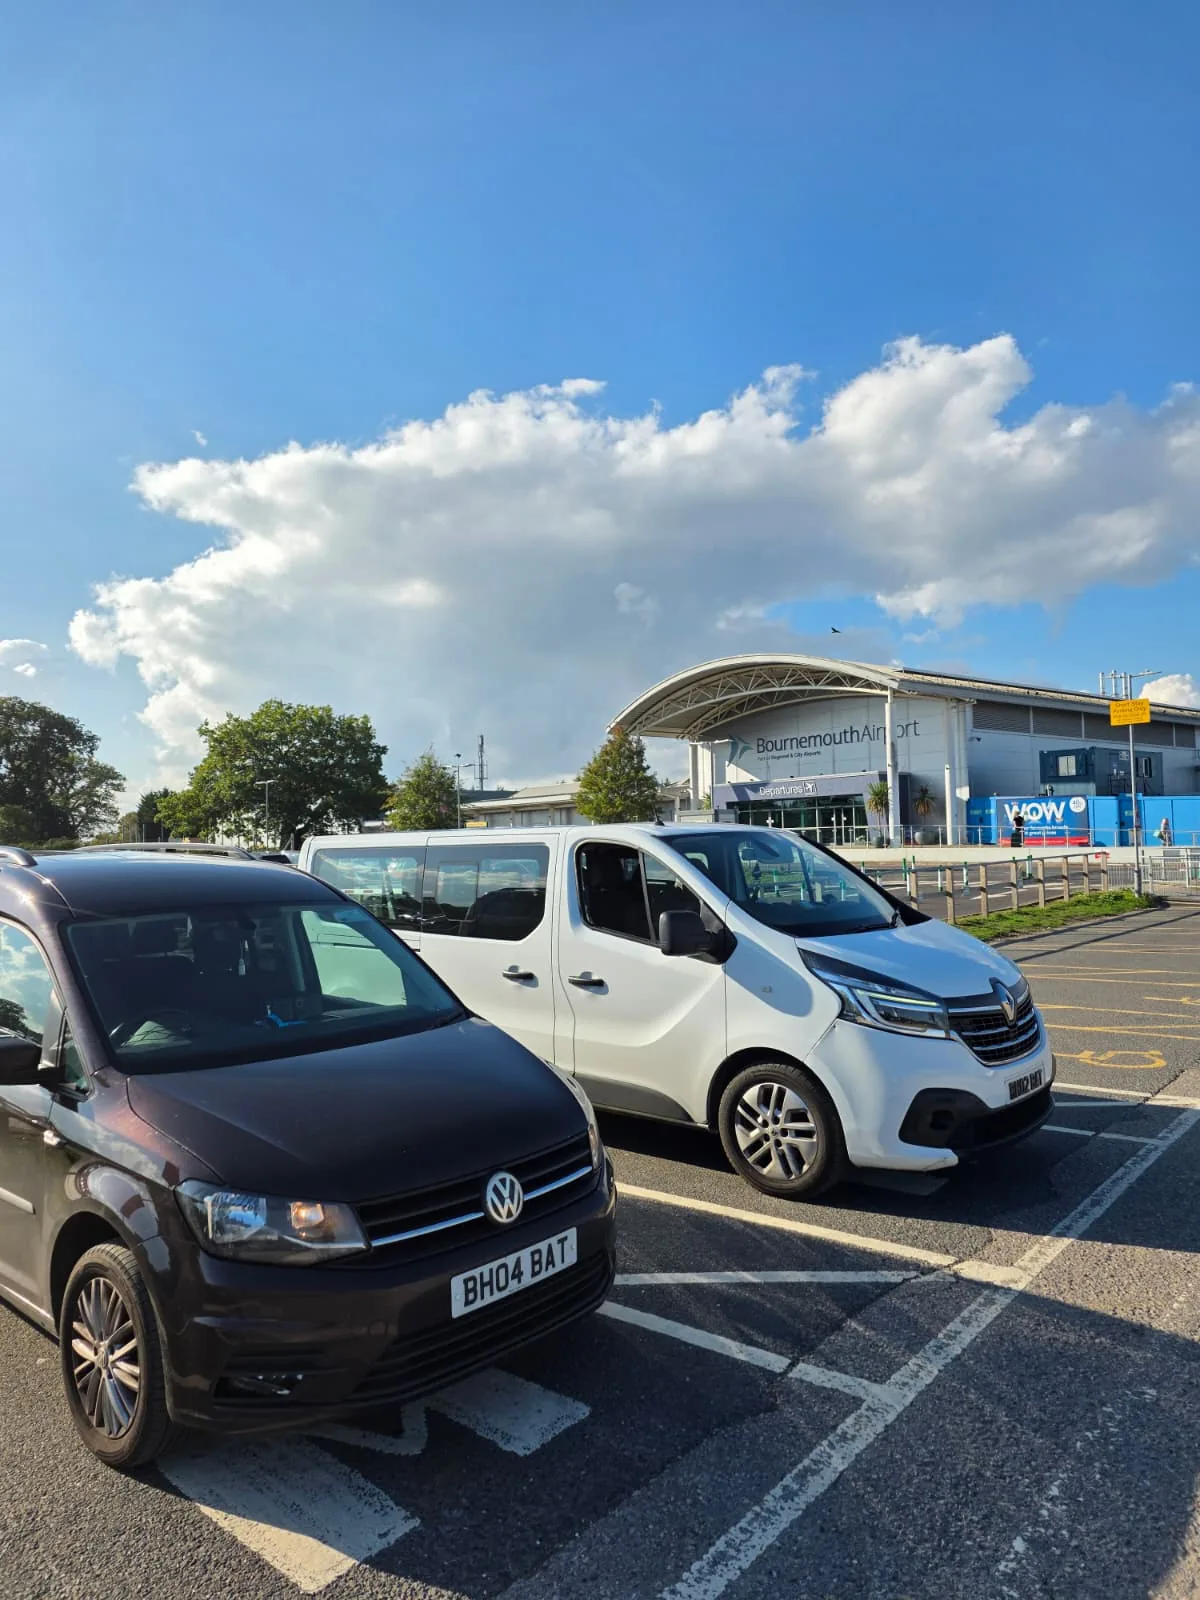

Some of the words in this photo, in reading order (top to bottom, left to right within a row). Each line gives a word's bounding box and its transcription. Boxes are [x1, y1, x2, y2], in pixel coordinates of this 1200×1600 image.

[760, 783, 803, 798] Departures
[1004, 801, 1066, 822] WOW
[463, 1255, 523, 1308] BH04
[530, 1236, 568, 1279] BAT
